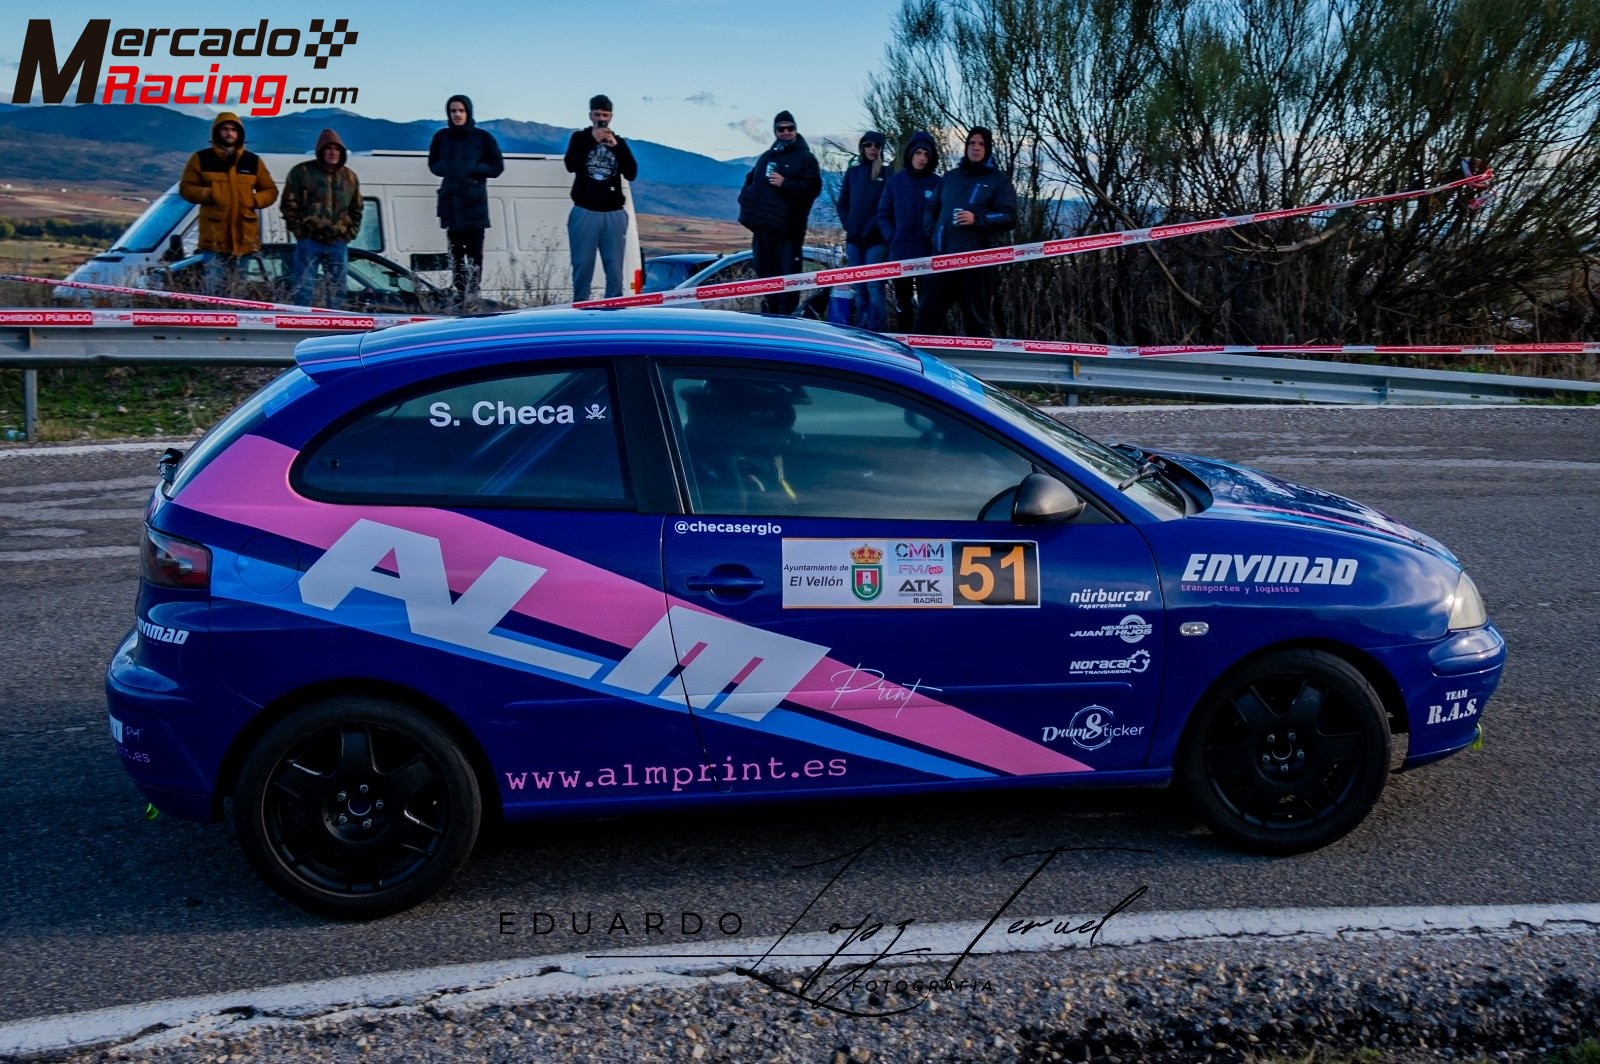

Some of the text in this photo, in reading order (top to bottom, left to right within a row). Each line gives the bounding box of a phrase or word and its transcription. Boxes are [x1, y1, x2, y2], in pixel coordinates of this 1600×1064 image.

[1079, 236, 1121, 247] PROHIBIDO
[969, 251, 1013, 262] PROHIBIDO
[817, 272, 854, 283] PÚBLICO
[855, 267, 901, 277] PROHIBIDO
[736, 281, 784, 293] PROHIBIDO
[45, 313, 92, 322] PÚBLICO
[134, 314, 191, 323] PROHIBIDO
[192, 315, 236, 323] PÚBLICO
[276, 317, 331, 326] PROHIBIDO
[331, 318, 374, 327] PÚBLICO
[908, 336, 953, 345] PROHIBIDO
[1025, 342, 1070, 351] PROHIBIDO
[429, 401, 575, 427] S. Checa
[674, 521, 782, 536] @checasergio
[895, 543, 945, 558] CMM
[784, 563, 849, 572] Ayuntamiento de
[958, 546, 1027, 601] 51
[790, 574, 844, 587] El Vellón
[898, 579, 942, 592] ATK
[1181, 584, 1240, 593] transportes
[1245, 587, 1250, 595] y
[1069, 589, 1152, 603] nürburcar
[1079, 602, 1127, 610] reparaciones
[298, 518, 832, 722] ALM
[1446, 688, 1468, 700] TEAM
[1426, 698, 1478, 725] R.A.S.
[505, 755, 848, 792] www.almprint.es
